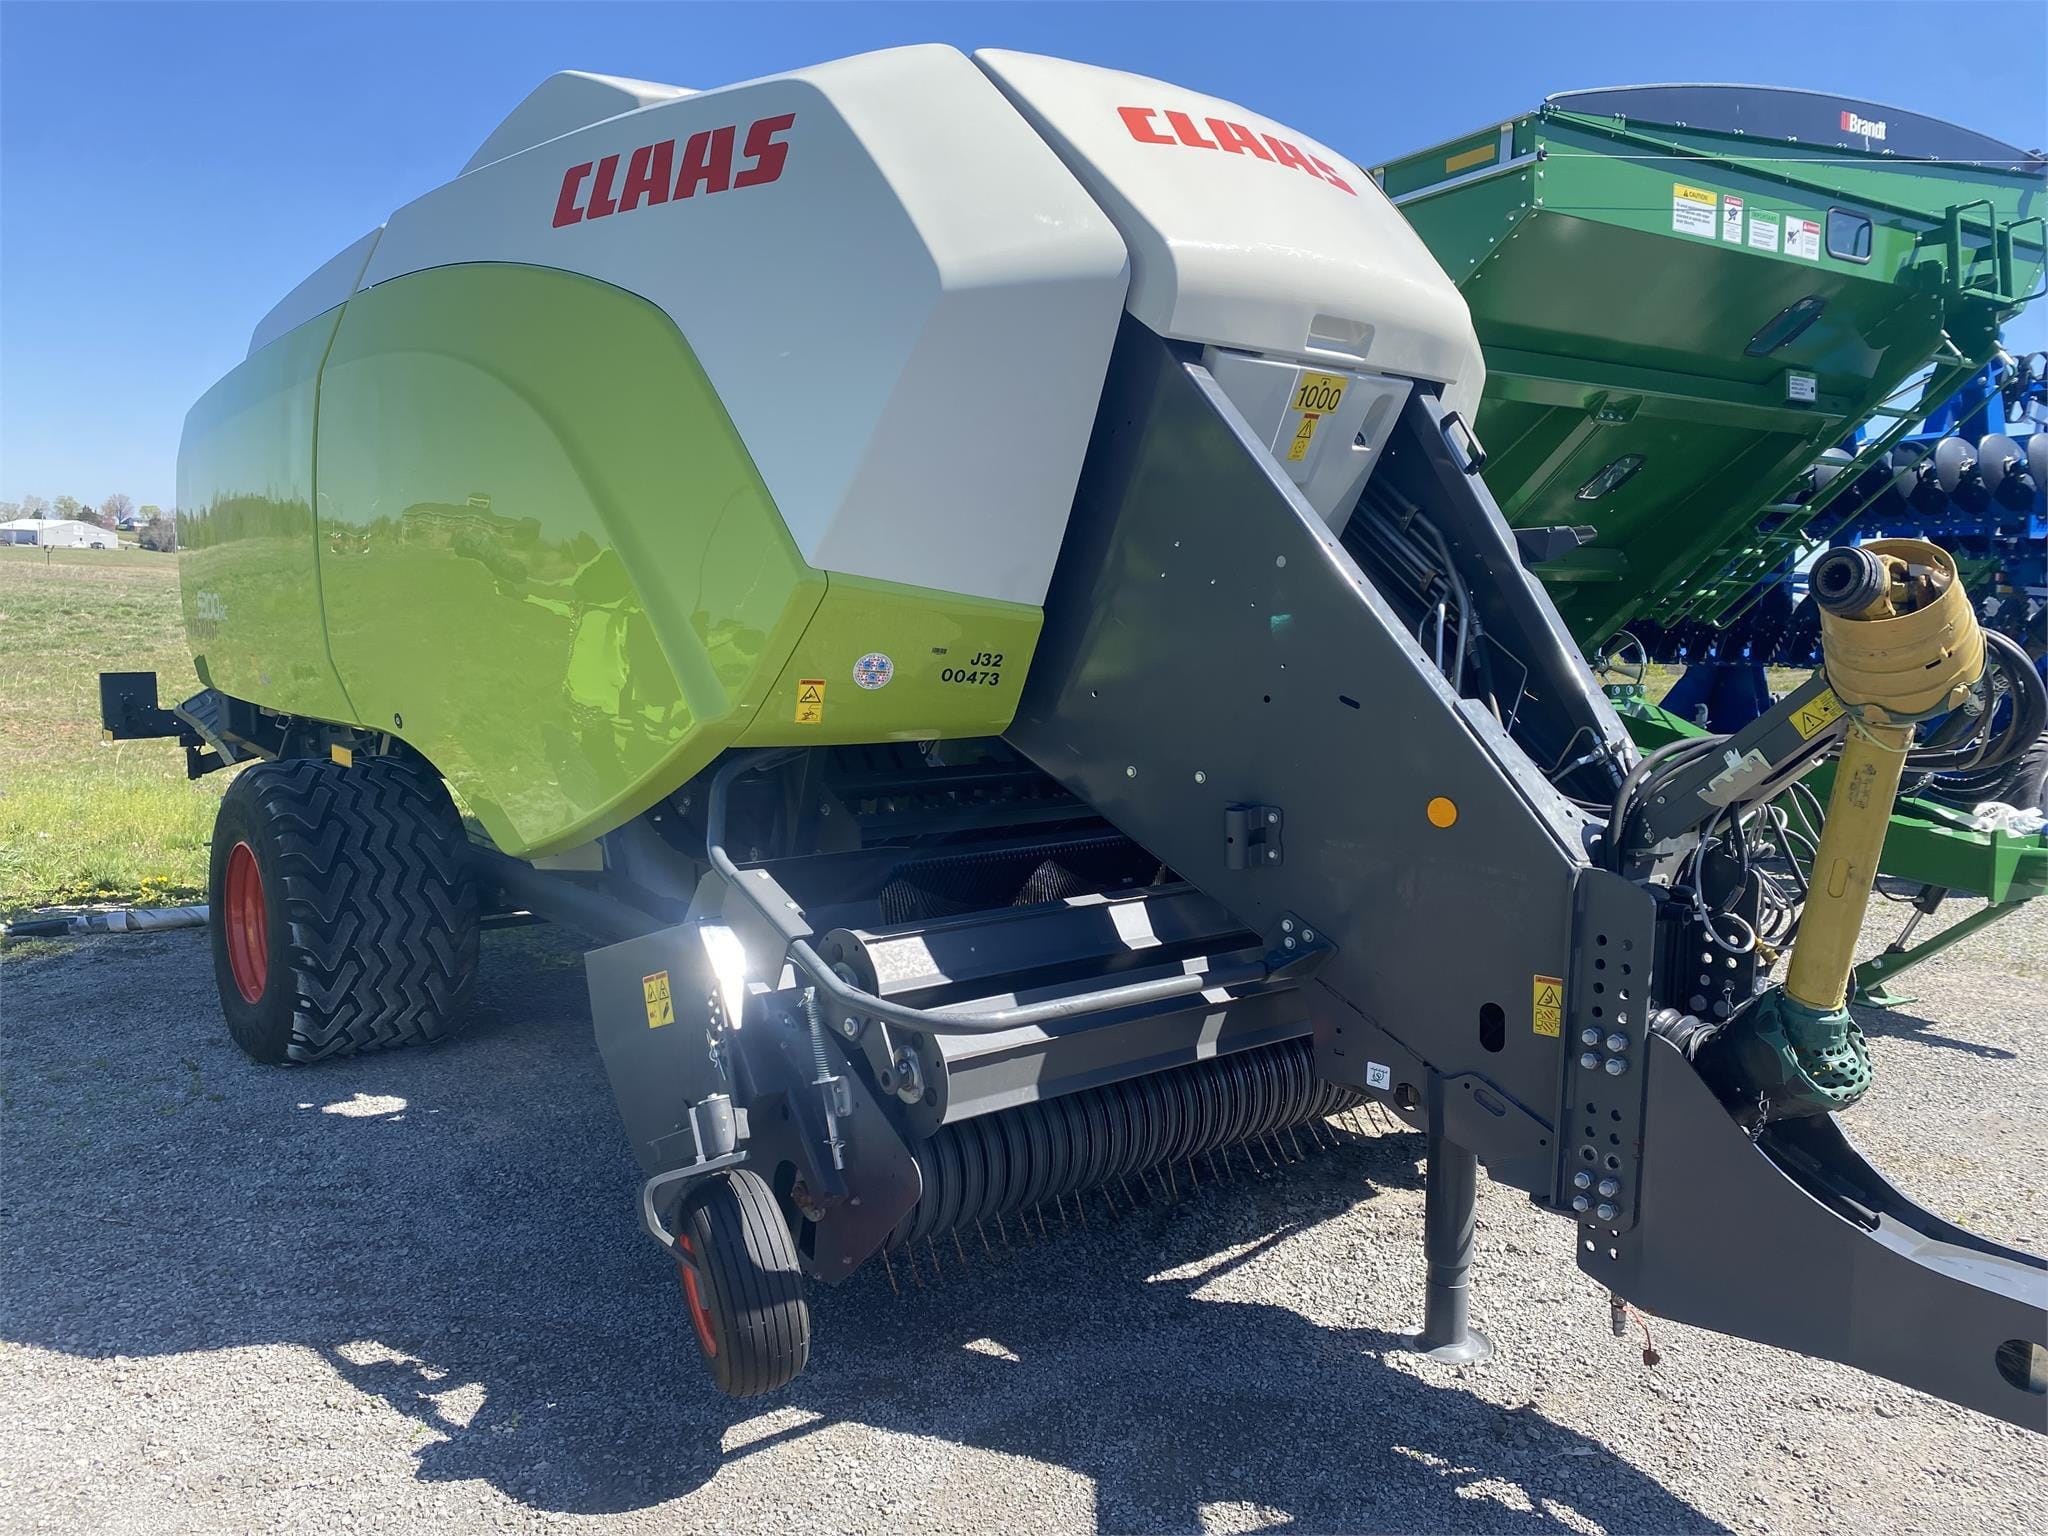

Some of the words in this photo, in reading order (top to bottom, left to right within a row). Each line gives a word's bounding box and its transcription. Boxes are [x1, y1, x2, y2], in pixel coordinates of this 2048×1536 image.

[1850, 112, 1887, 140] Brandt
[1117, 106, 1358, 197] CLAAS
[552, 112, 797, 229] CLAAS
[1298, 384, 1342, 411] 1000
[970, 652, 1004, 668] J32
[941, 668, 1000, 686] 00473
